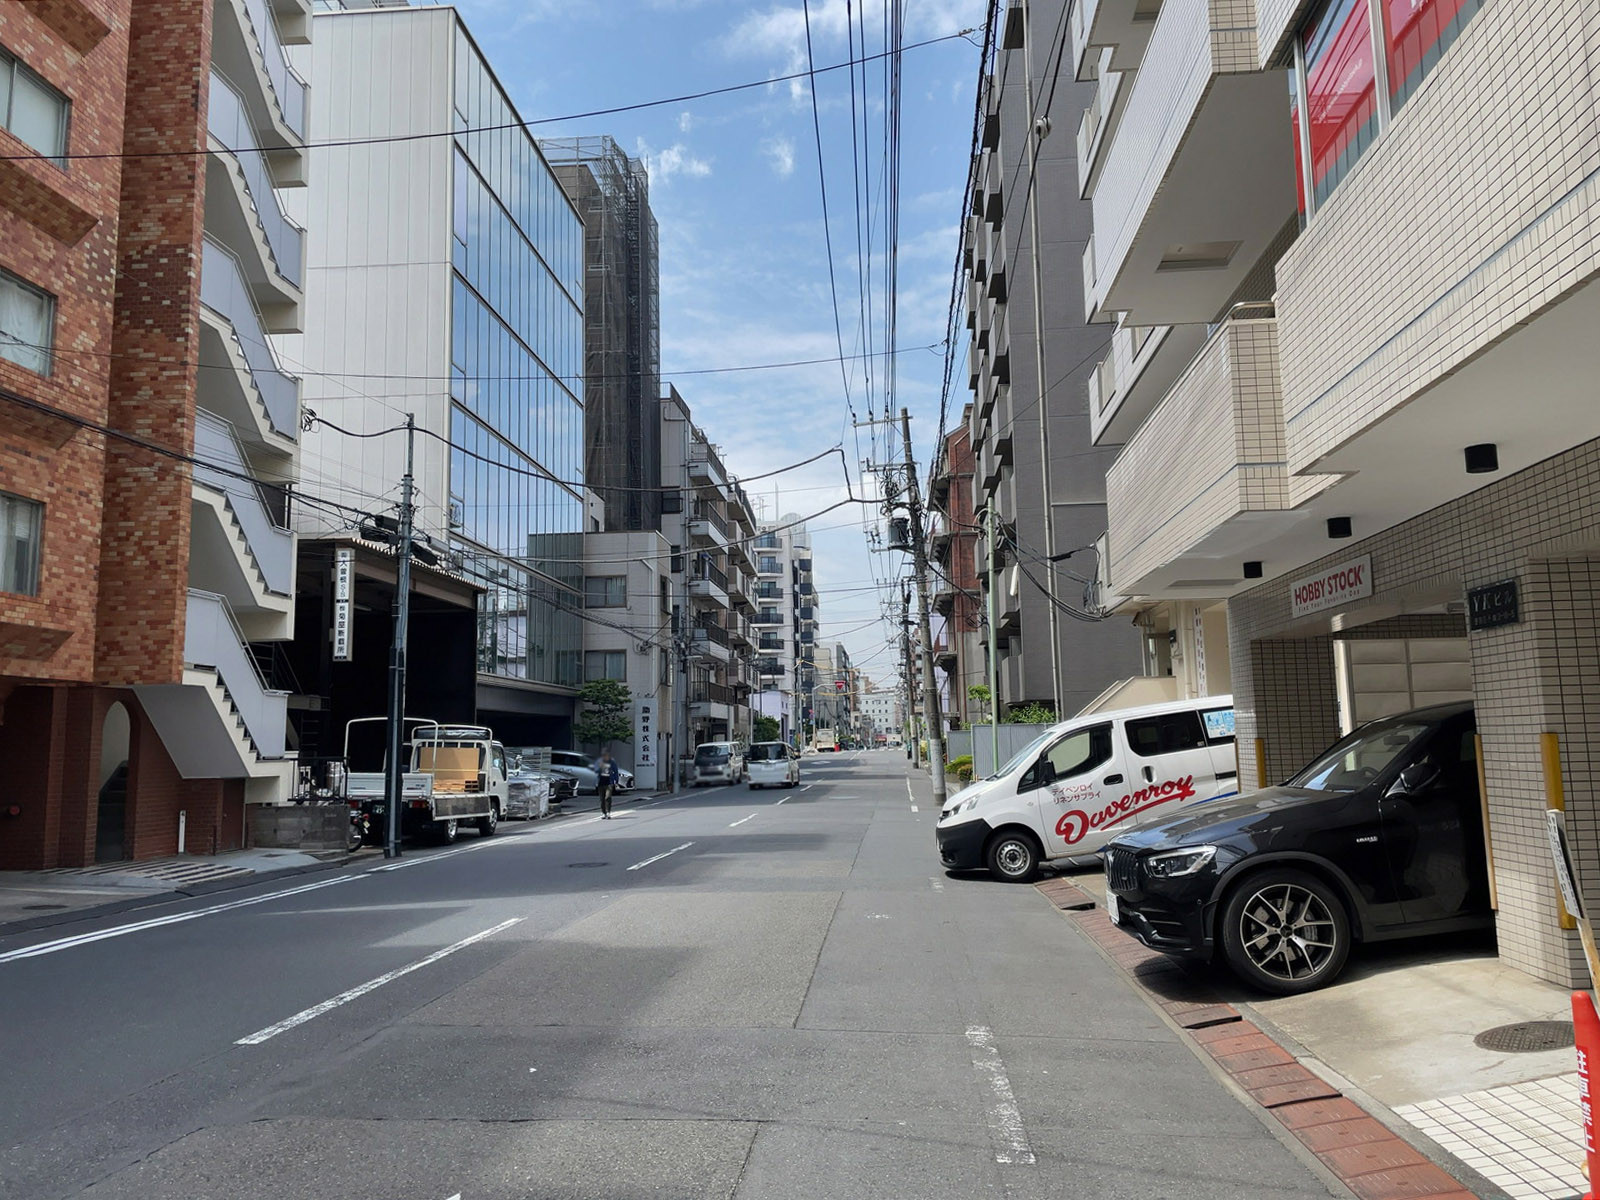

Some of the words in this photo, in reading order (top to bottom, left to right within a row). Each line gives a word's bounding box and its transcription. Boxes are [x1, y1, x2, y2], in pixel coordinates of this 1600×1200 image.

[1294, 577, 1326, 606] HOBBY
[1327, 564, 1363, 595] STOCK
[1055, 774, 1196, 845] Davenroy
